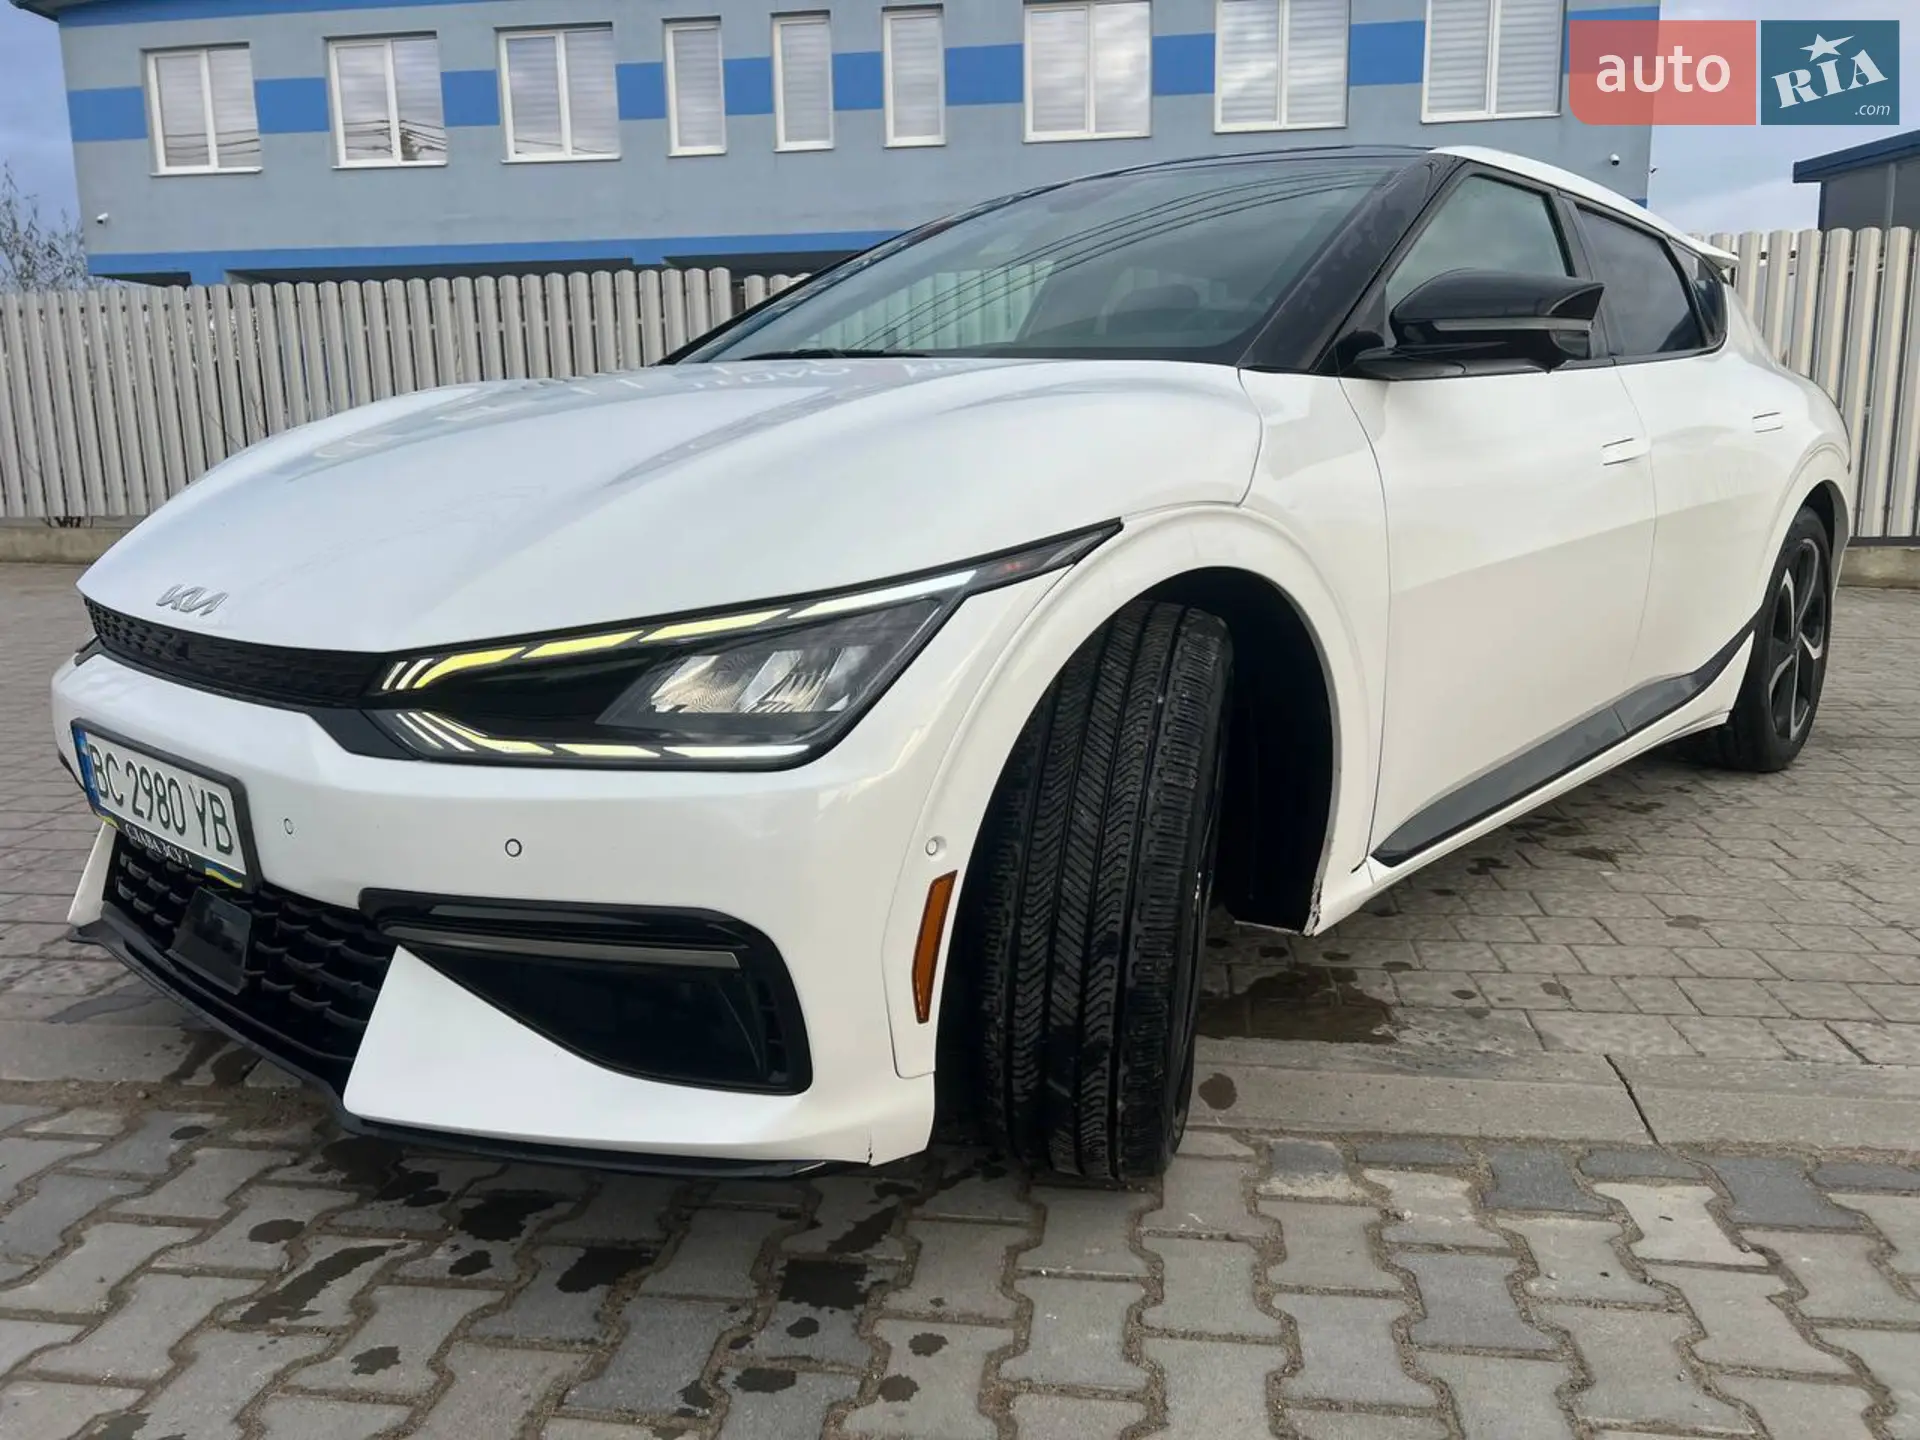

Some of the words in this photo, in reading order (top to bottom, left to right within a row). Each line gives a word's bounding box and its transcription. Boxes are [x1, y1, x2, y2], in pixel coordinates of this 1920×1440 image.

[88, 743, 124, 807] BC
[126, 760, 187, 836] 2980
[188, 784, 235, 855] YB
